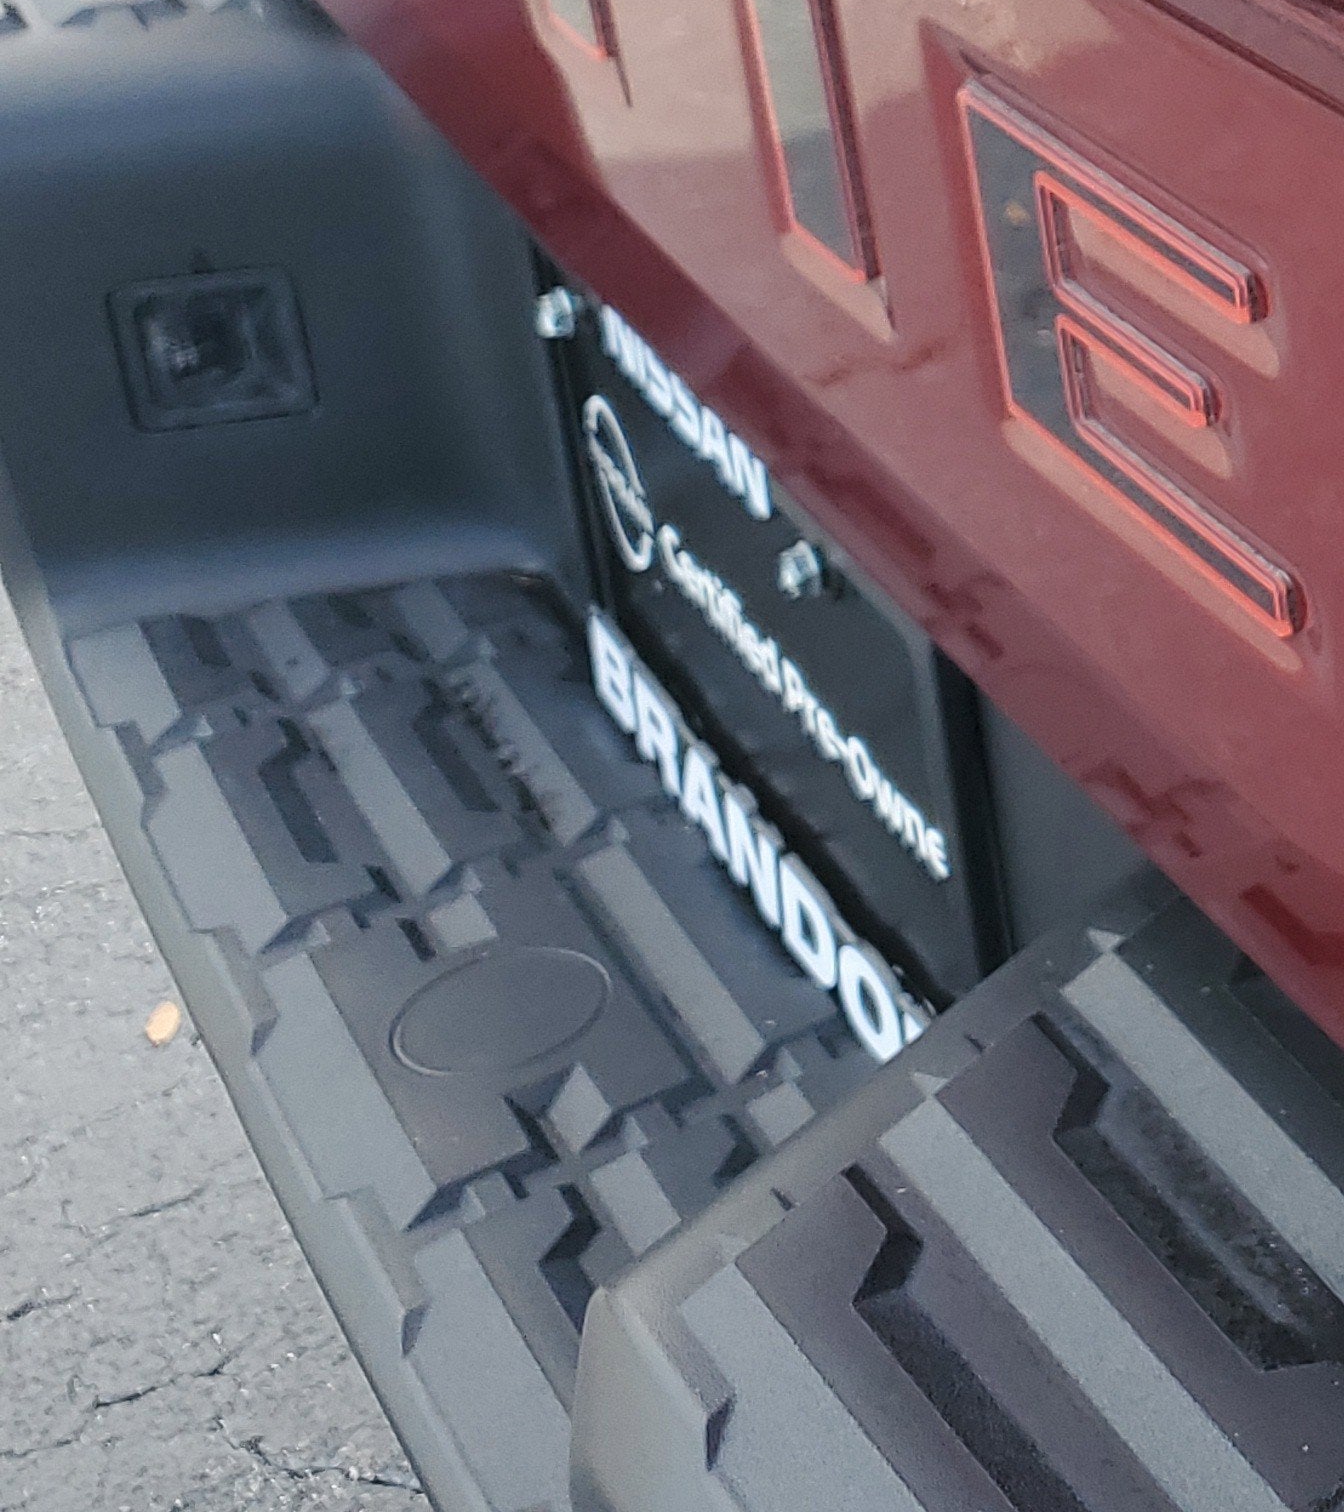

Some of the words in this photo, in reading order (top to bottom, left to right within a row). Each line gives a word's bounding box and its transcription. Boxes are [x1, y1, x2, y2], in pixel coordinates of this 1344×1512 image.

[600, 302, 774, 522] NISSAN
[656, 522, 784, 694] Certified
[586, 610, 926, 1064] BRANDO
